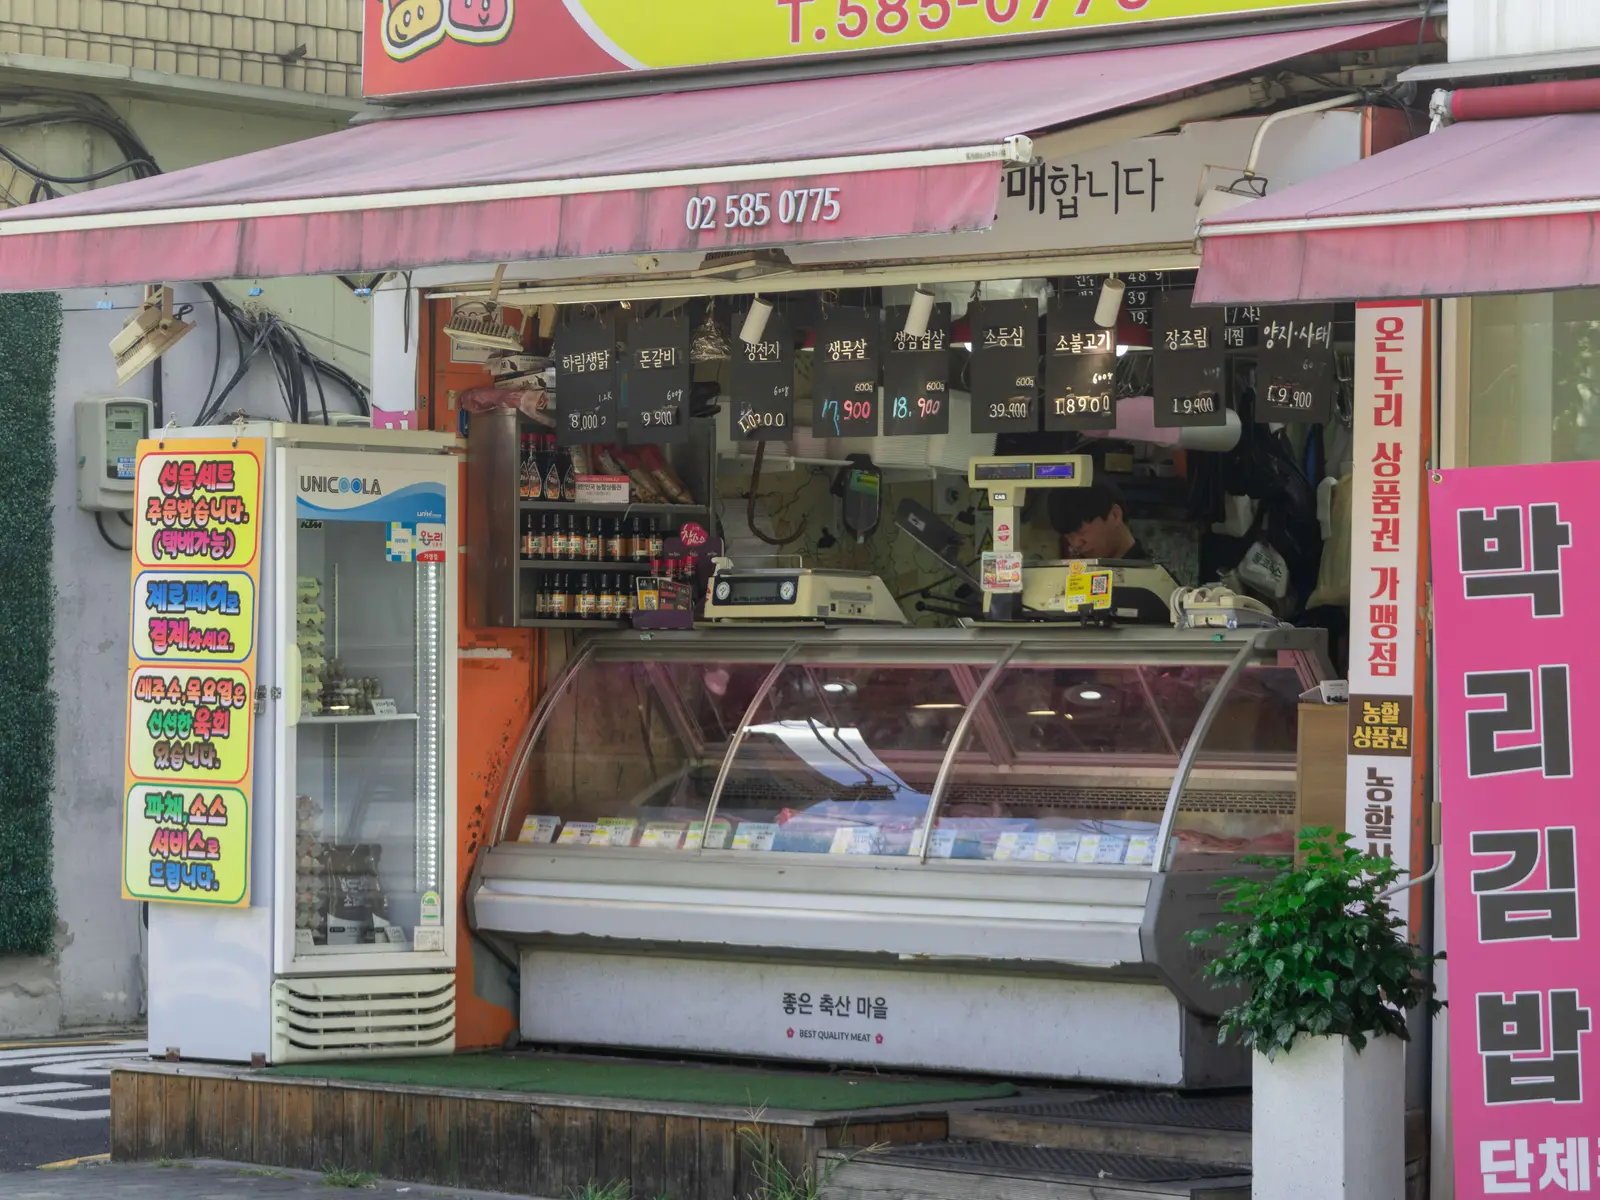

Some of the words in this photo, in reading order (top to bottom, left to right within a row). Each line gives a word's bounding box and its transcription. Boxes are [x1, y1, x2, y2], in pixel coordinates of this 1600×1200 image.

[997, 158, 1165, 222] 매합니다
[686, 196, 716, 231] 02
[725, 192, 771, 228] 585
[778, 187, 841, 224] 0775
[827, 338, 868, 361] 생목살
[984, 326, 1024, 348] 소등심
[1055, 330, 1112, 354] 소불고기
[1165, 327, 1208, 351] 장조림
[562, 350, 611, 374] 하림생닭
[639, 347, 676, 370] 돈갈비
[744, 341, 780, 362] 생전지
[1015, 375, 1035, 387] 600g
[1374, 316, 1405, 428] 온누리
[854, 382, 874, 393] 600g
[926, 381, 945, 393] 600g
[157, 460, 235, 495] 선물세트
[1369, 442, 1403, 553] 상품권
[151, 526, 236, 560] (택배가능)
[145, 580, 240, 614] 제로페이로
[1367, 566, 1400, 677] 가맹점
[148, 616, 235, 655] 결제하세요.
[1362, 700, 1400, 725] 농할
[1352, 724, 1409, 750] 상품권
[153, 740, 221, 771] 있습니다.
[149, 860, 220, 892] 드립니다.
[782, 992, 813, 1015] 좋은
[818, 994, 851, 1018] 축산
[857, 997, 888, 1020] 마을
[799, 1029, 816, 1038] BEST
[818, 1030, 849, 1041] QUALITY
[850, 1033, 871, 1042] MEAT
[1479, 1137, 1600, 1194] 단체
